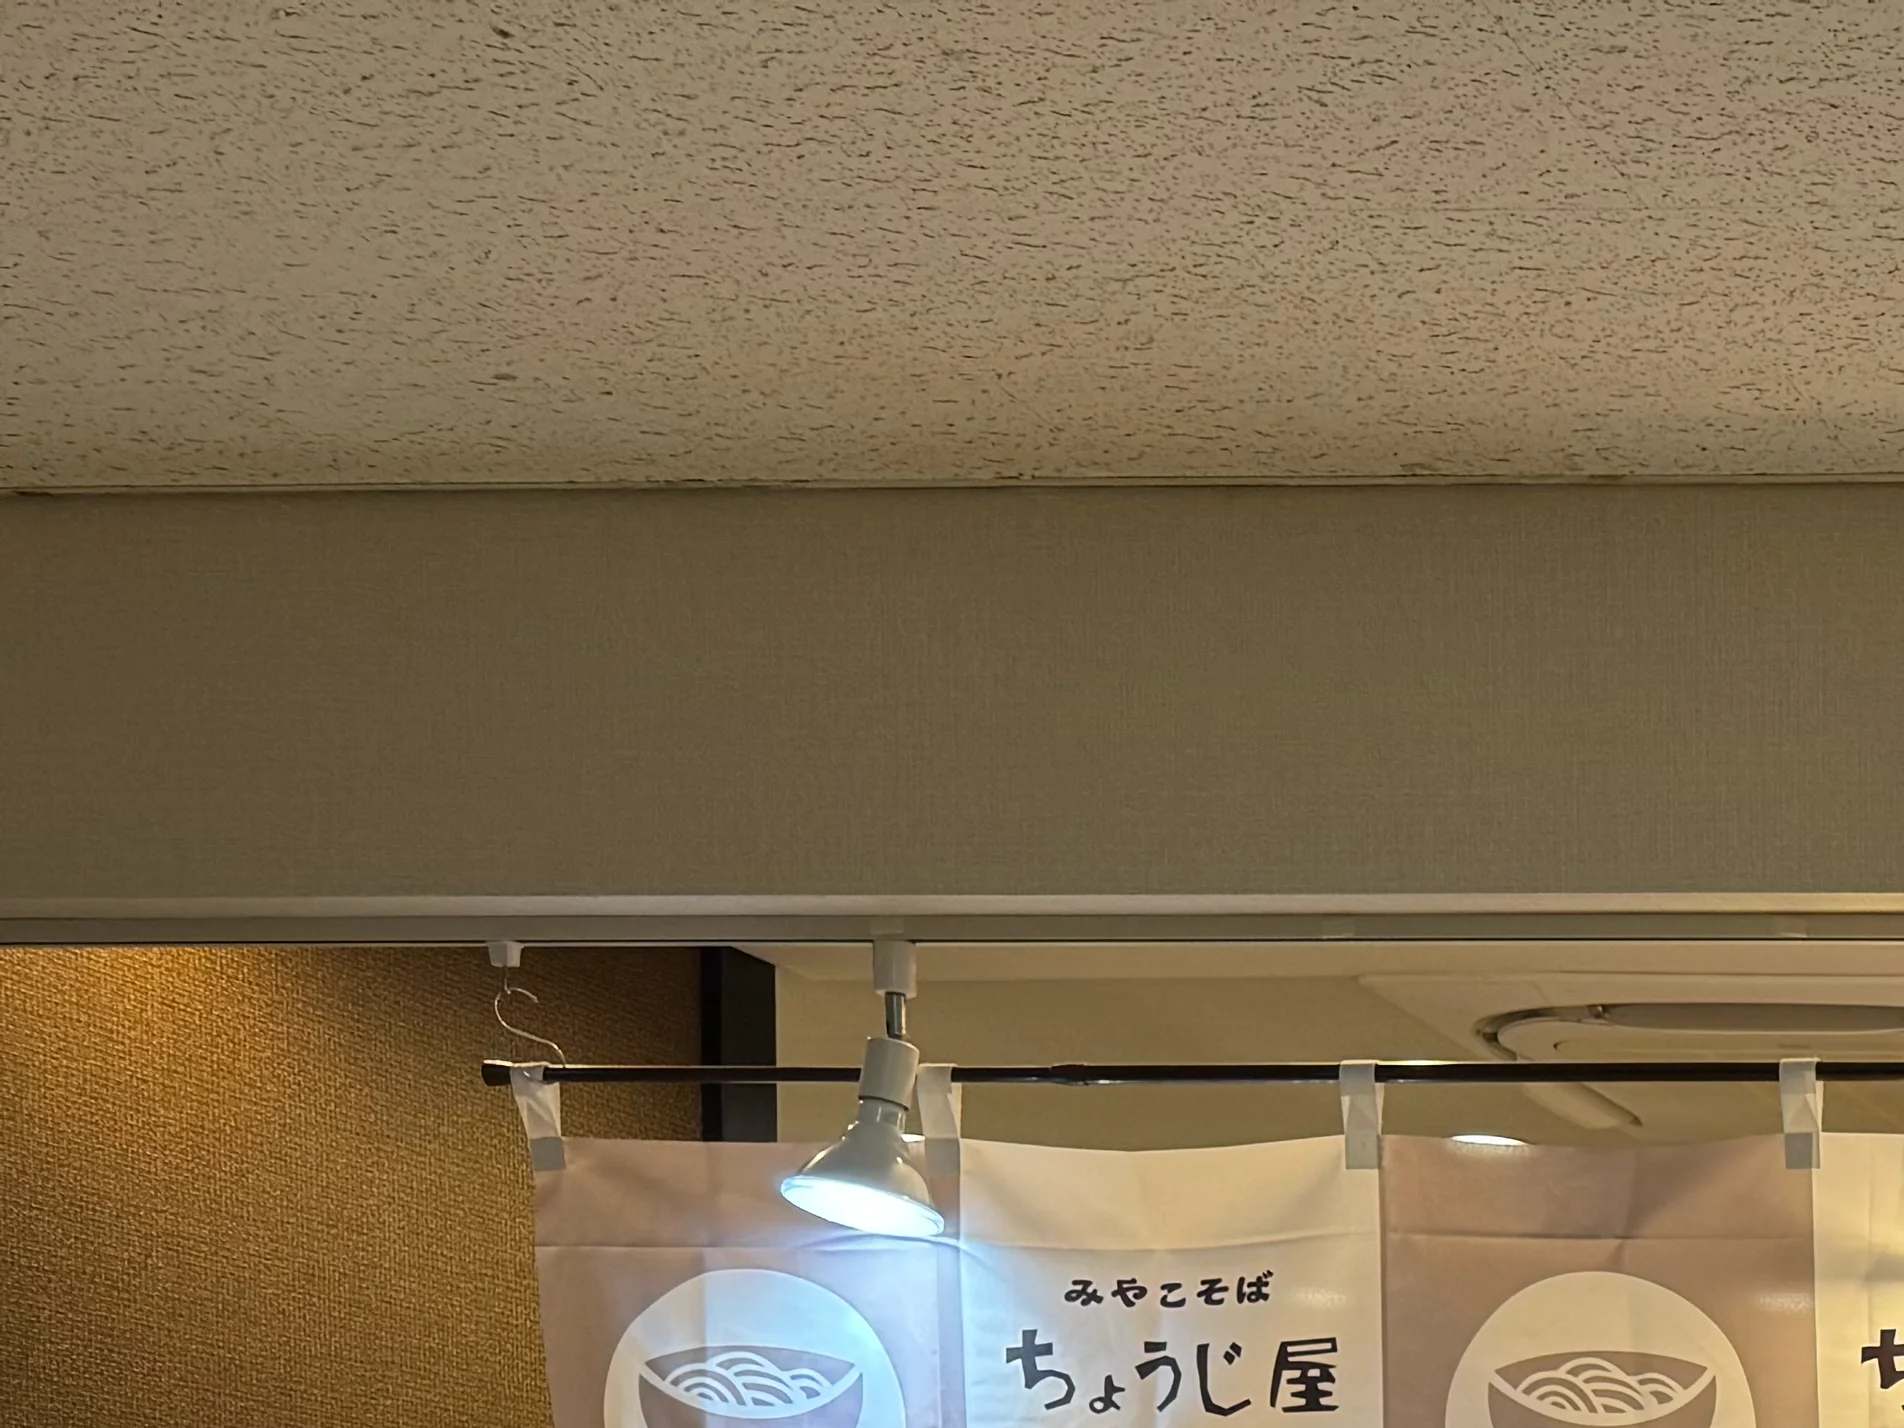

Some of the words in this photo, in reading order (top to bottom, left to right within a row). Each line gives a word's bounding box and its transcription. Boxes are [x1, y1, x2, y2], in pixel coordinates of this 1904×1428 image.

[1064, 1269, 1275, 1309] みやこそば
[1004, 1326, 1341, 1418] ちょうじ屋
